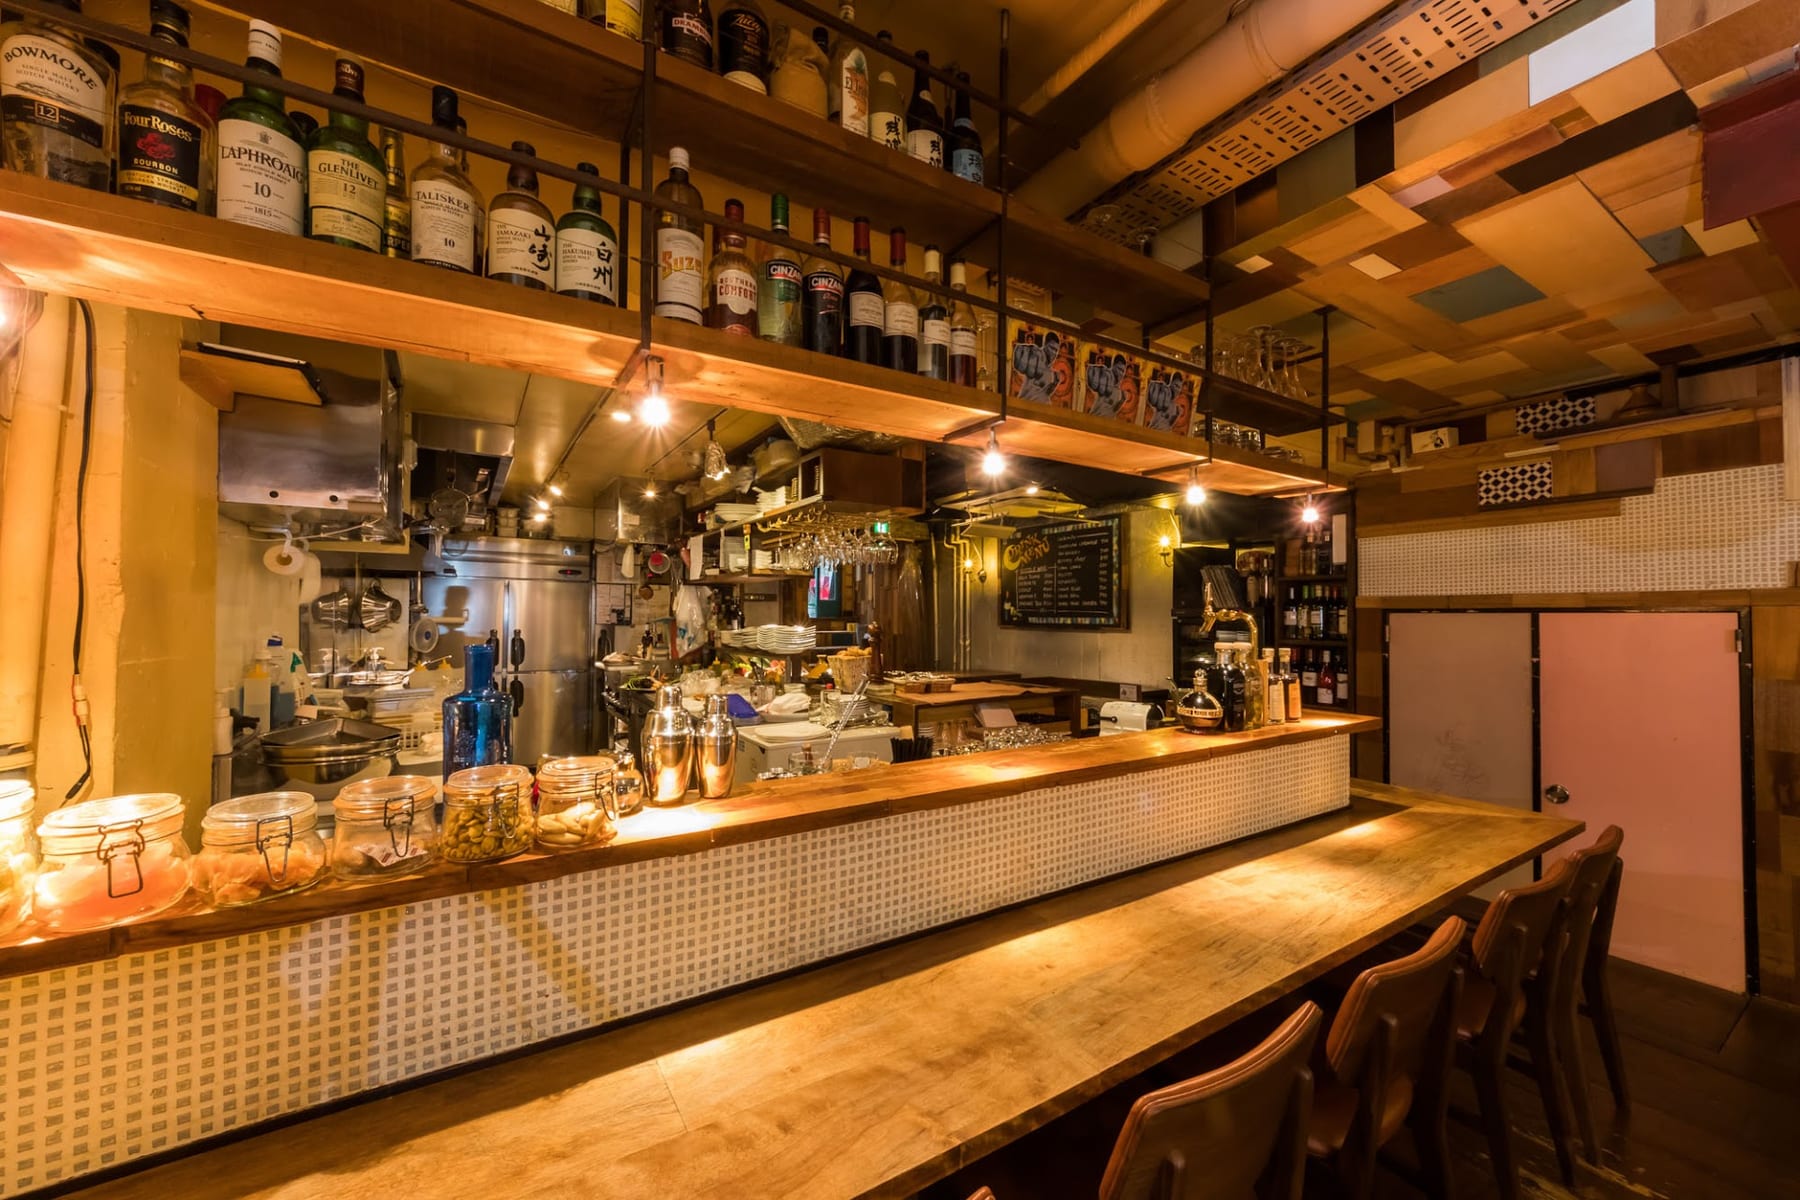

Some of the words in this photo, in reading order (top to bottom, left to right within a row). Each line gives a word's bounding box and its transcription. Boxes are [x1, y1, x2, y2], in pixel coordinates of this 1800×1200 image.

[4, 46, 97, 90] BOWMORE
[39, 105, 54, 119] 12
[124, 112, 151, 127] Four
[151, 115, 192, 142] Roses
[134, 158, 178, 174] BOURBON
[221, 146, 304, 185] LAPHROAIG
[341, 159, 360, 170] THE
[318, 162, 379, 190] GLENLIVET
[253, 182, 271, 198] 10
[343, 183, 356, 195] 12
[415, 190, 470, 212] TALISKER
[254, 206, 272, 218] 1815
[444, 237, 455, 248] 10
[593, 241, 613, 292] 白州
[770, 265, 802, 280] CINZAN
[719, 285, 757, 303] COMFORT
